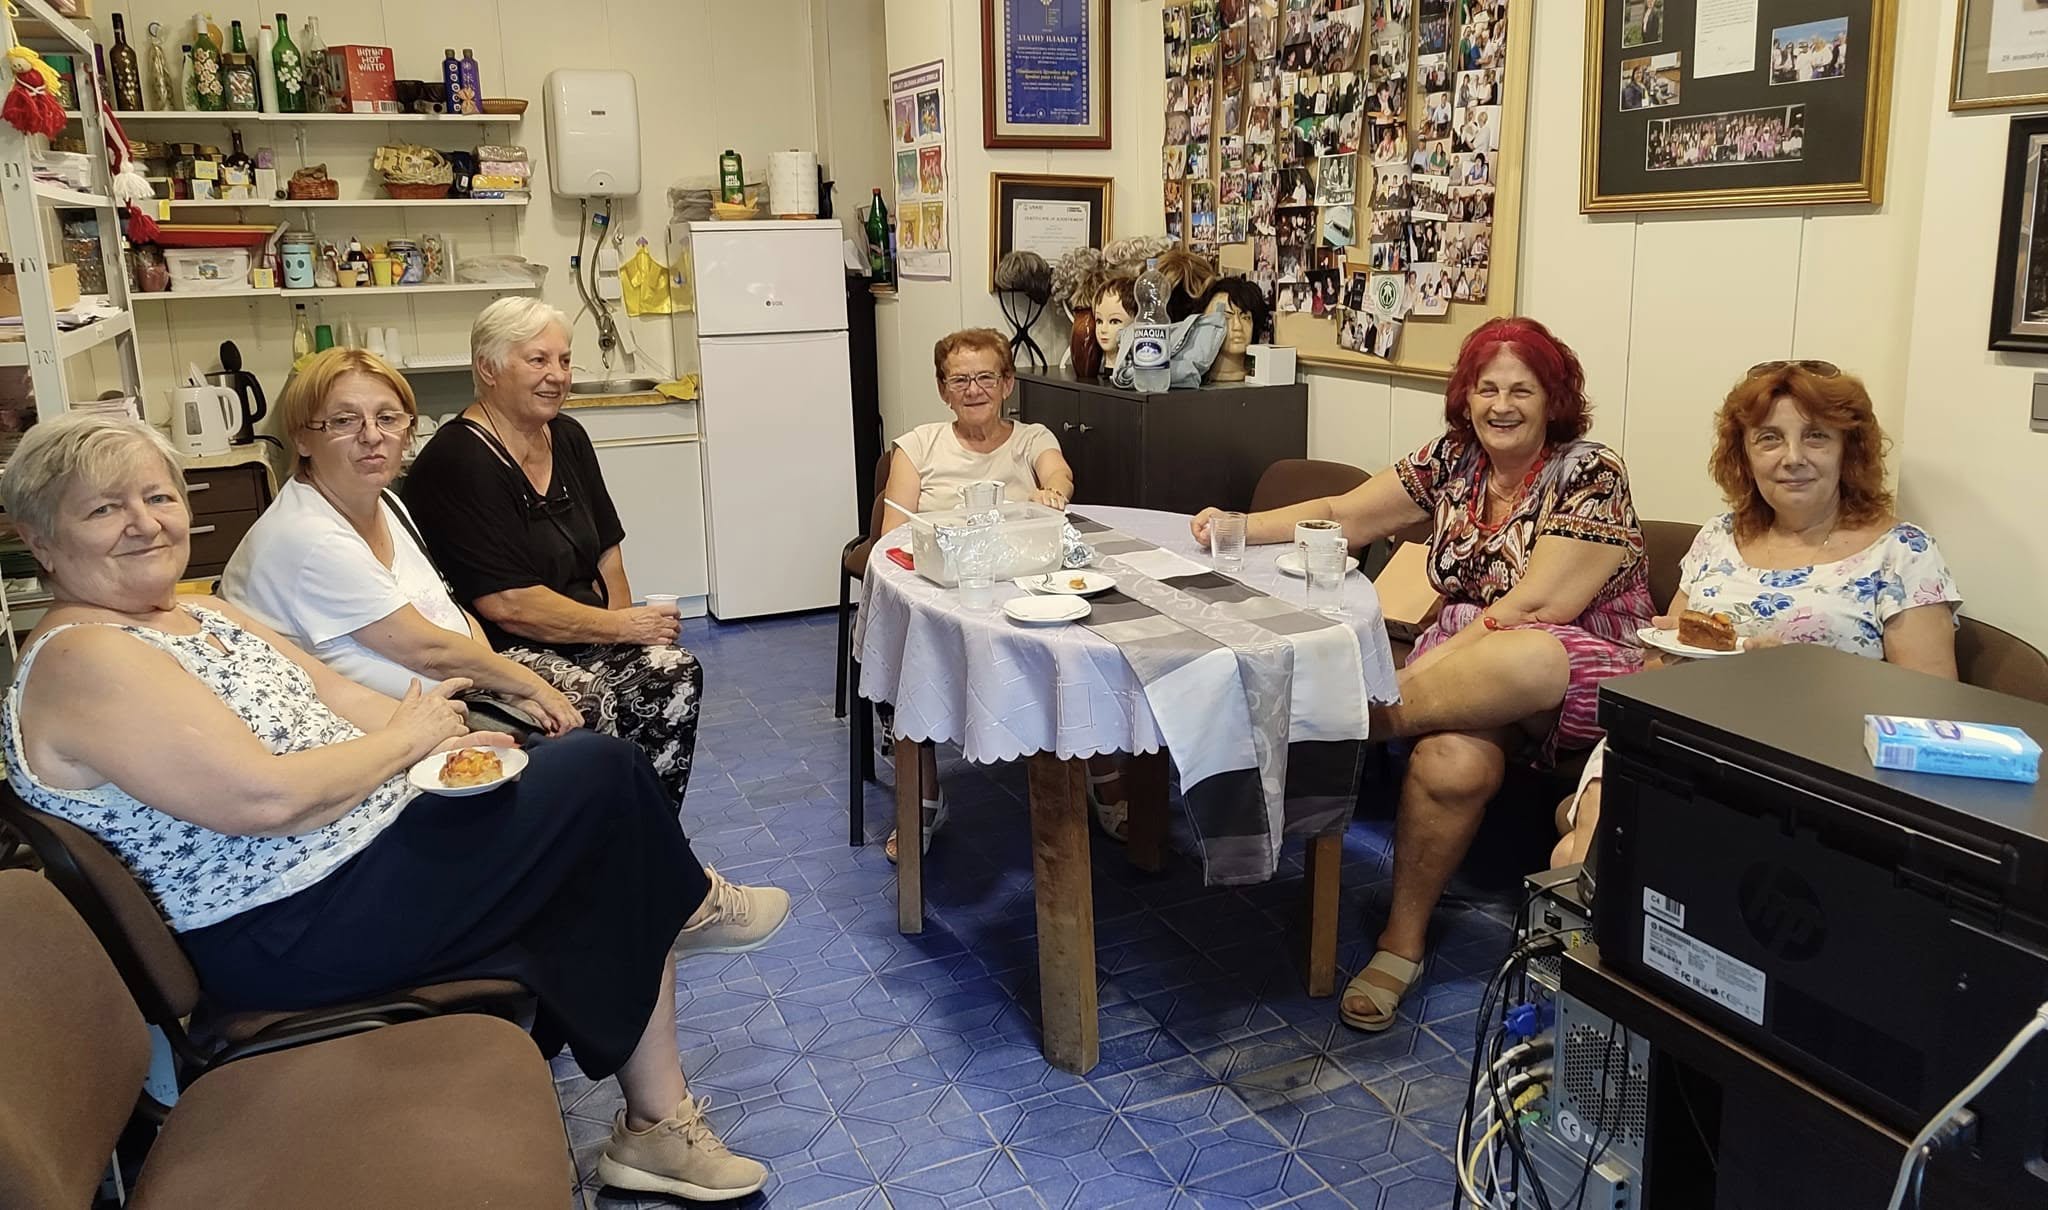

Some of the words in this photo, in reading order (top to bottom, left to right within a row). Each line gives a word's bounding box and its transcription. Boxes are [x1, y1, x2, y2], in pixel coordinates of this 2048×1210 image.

[356, 48, 384, 57] INSTANT
[361, 56, 381, 64] HOT
[358, 63, 386, 72] WATER
